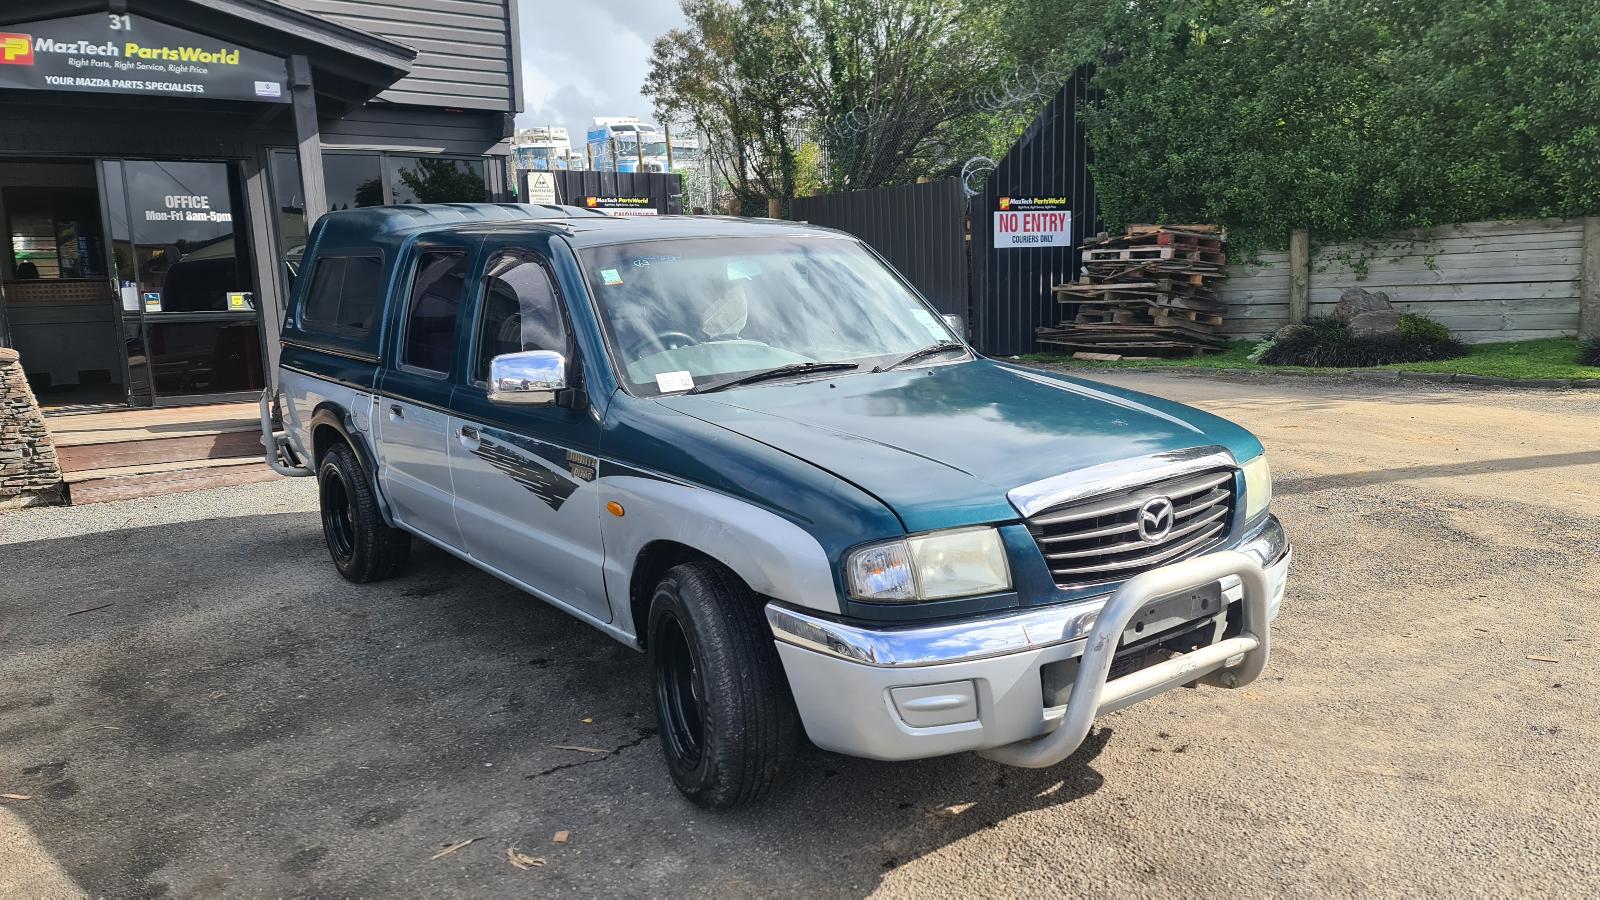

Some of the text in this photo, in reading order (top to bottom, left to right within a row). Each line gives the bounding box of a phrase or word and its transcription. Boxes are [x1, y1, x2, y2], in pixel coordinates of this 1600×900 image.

[109, 14, 131, 31] 31
[34, 37, 240, 65] MazTech PartsWorld
[68, 57, 208, 74] Right Parts, Right Service, Right Price
[45, 75, 205, 93] YOUR MAZDA PARTS SPECIALISTS
[164, 194, 210, 209] OFFICE
[145, 210, 232, 223] Mon-Fri 8am-5pm
[999, 212, 1066, 233] NO ENTRY
[1012, 234, 1053, 244] COURIERS ONLY
